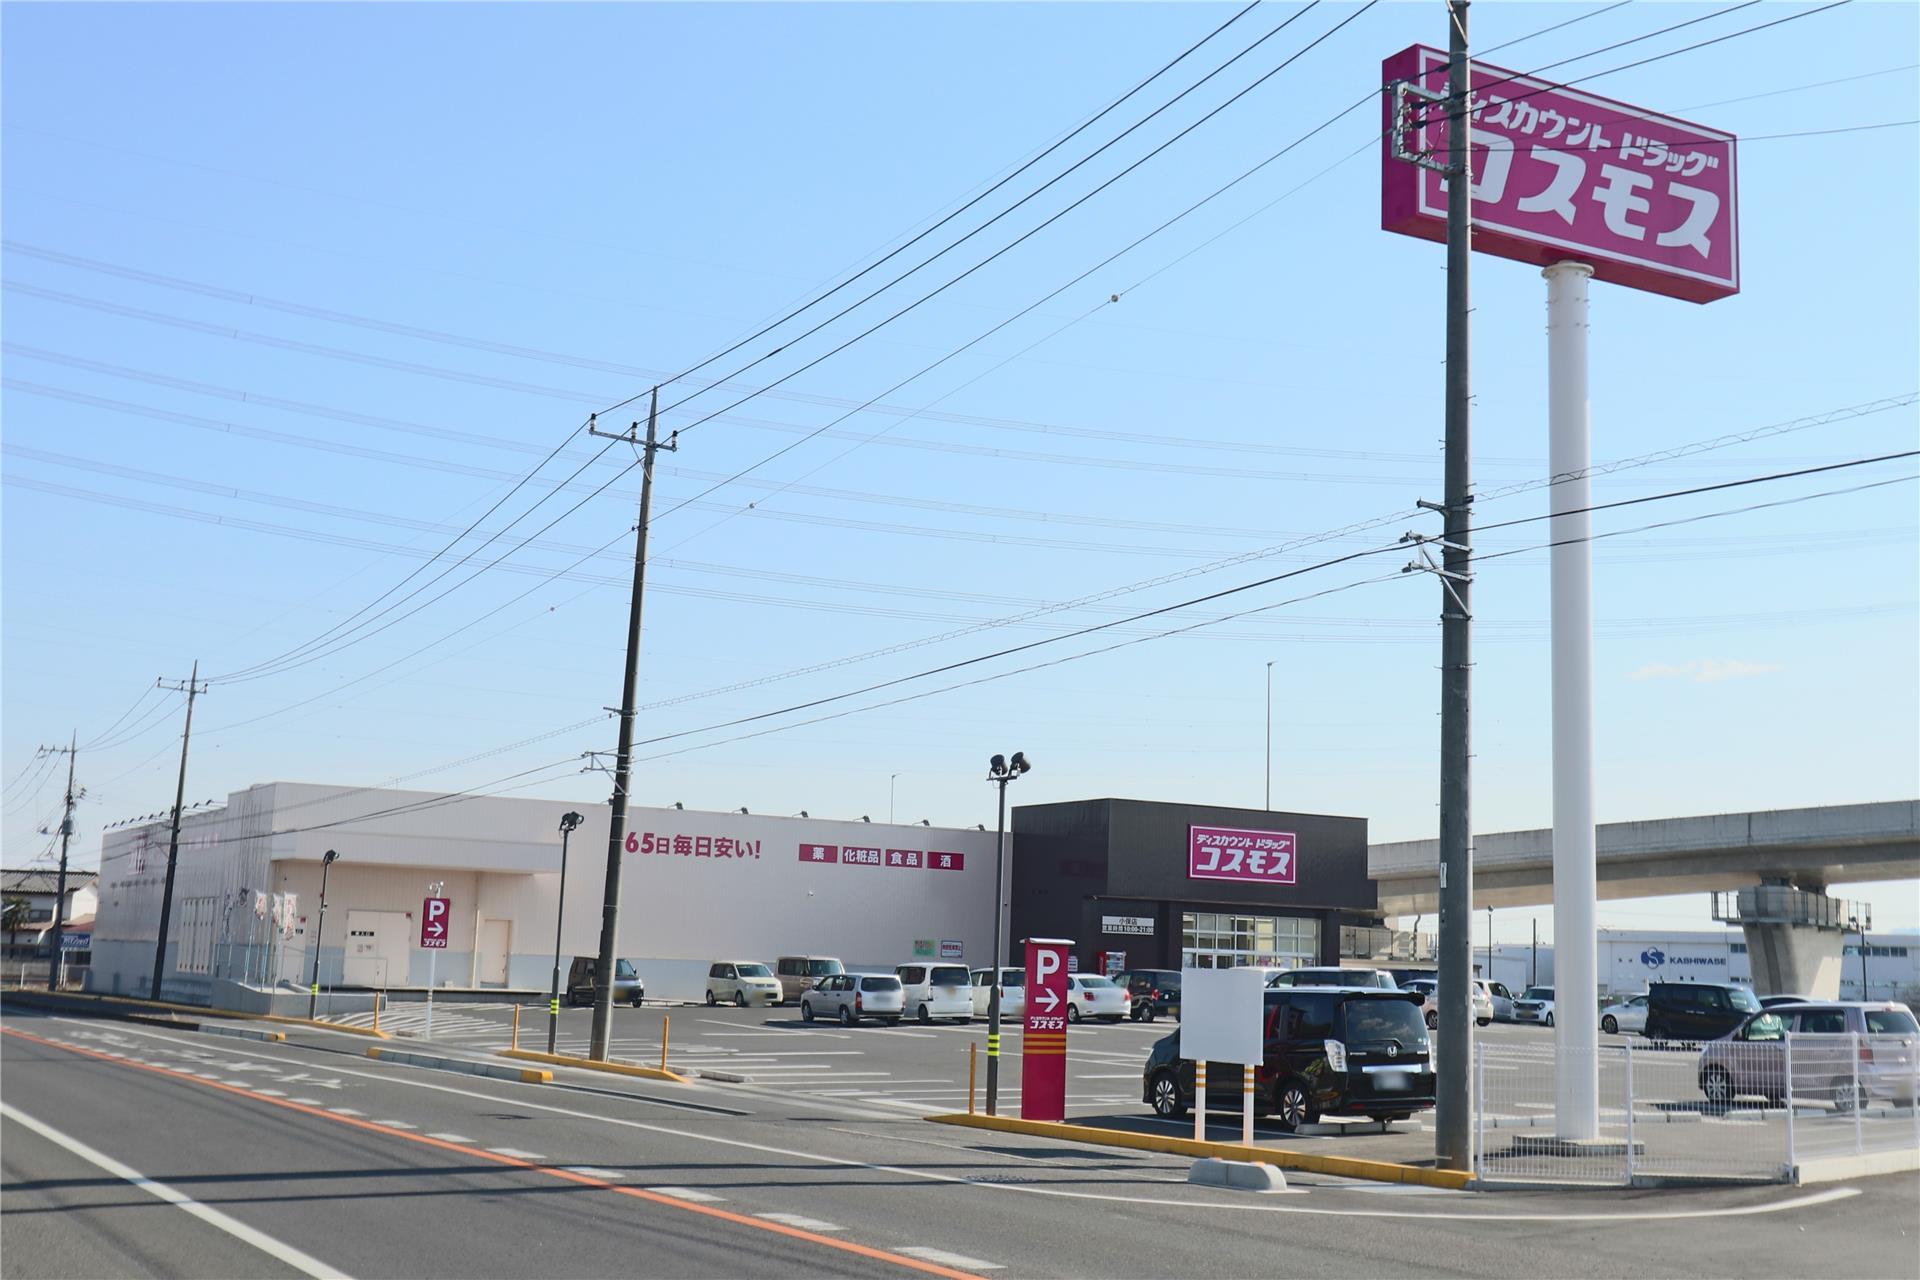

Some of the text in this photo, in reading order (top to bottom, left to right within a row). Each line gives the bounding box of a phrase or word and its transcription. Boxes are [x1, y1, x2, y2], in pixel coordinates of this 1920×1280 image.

[1440, 82, 1719, 178] ィスカウント ドラッグ
[1439, 127, 1720, 260] コスモス
[1196, 834, 1291, 850] ディスカウント ドラッグ
[812, 847, 825, 860] 薬
[844, 849, 879, 864] 化粧品
[940, 855, 952, 868] 酒
[1196, 846, 1291, 876] コスモス
[428, 900, 445, 921] P
[1036, 949, 1061, 985] P
[1030, 1020, 1064, 1029] コスモス
